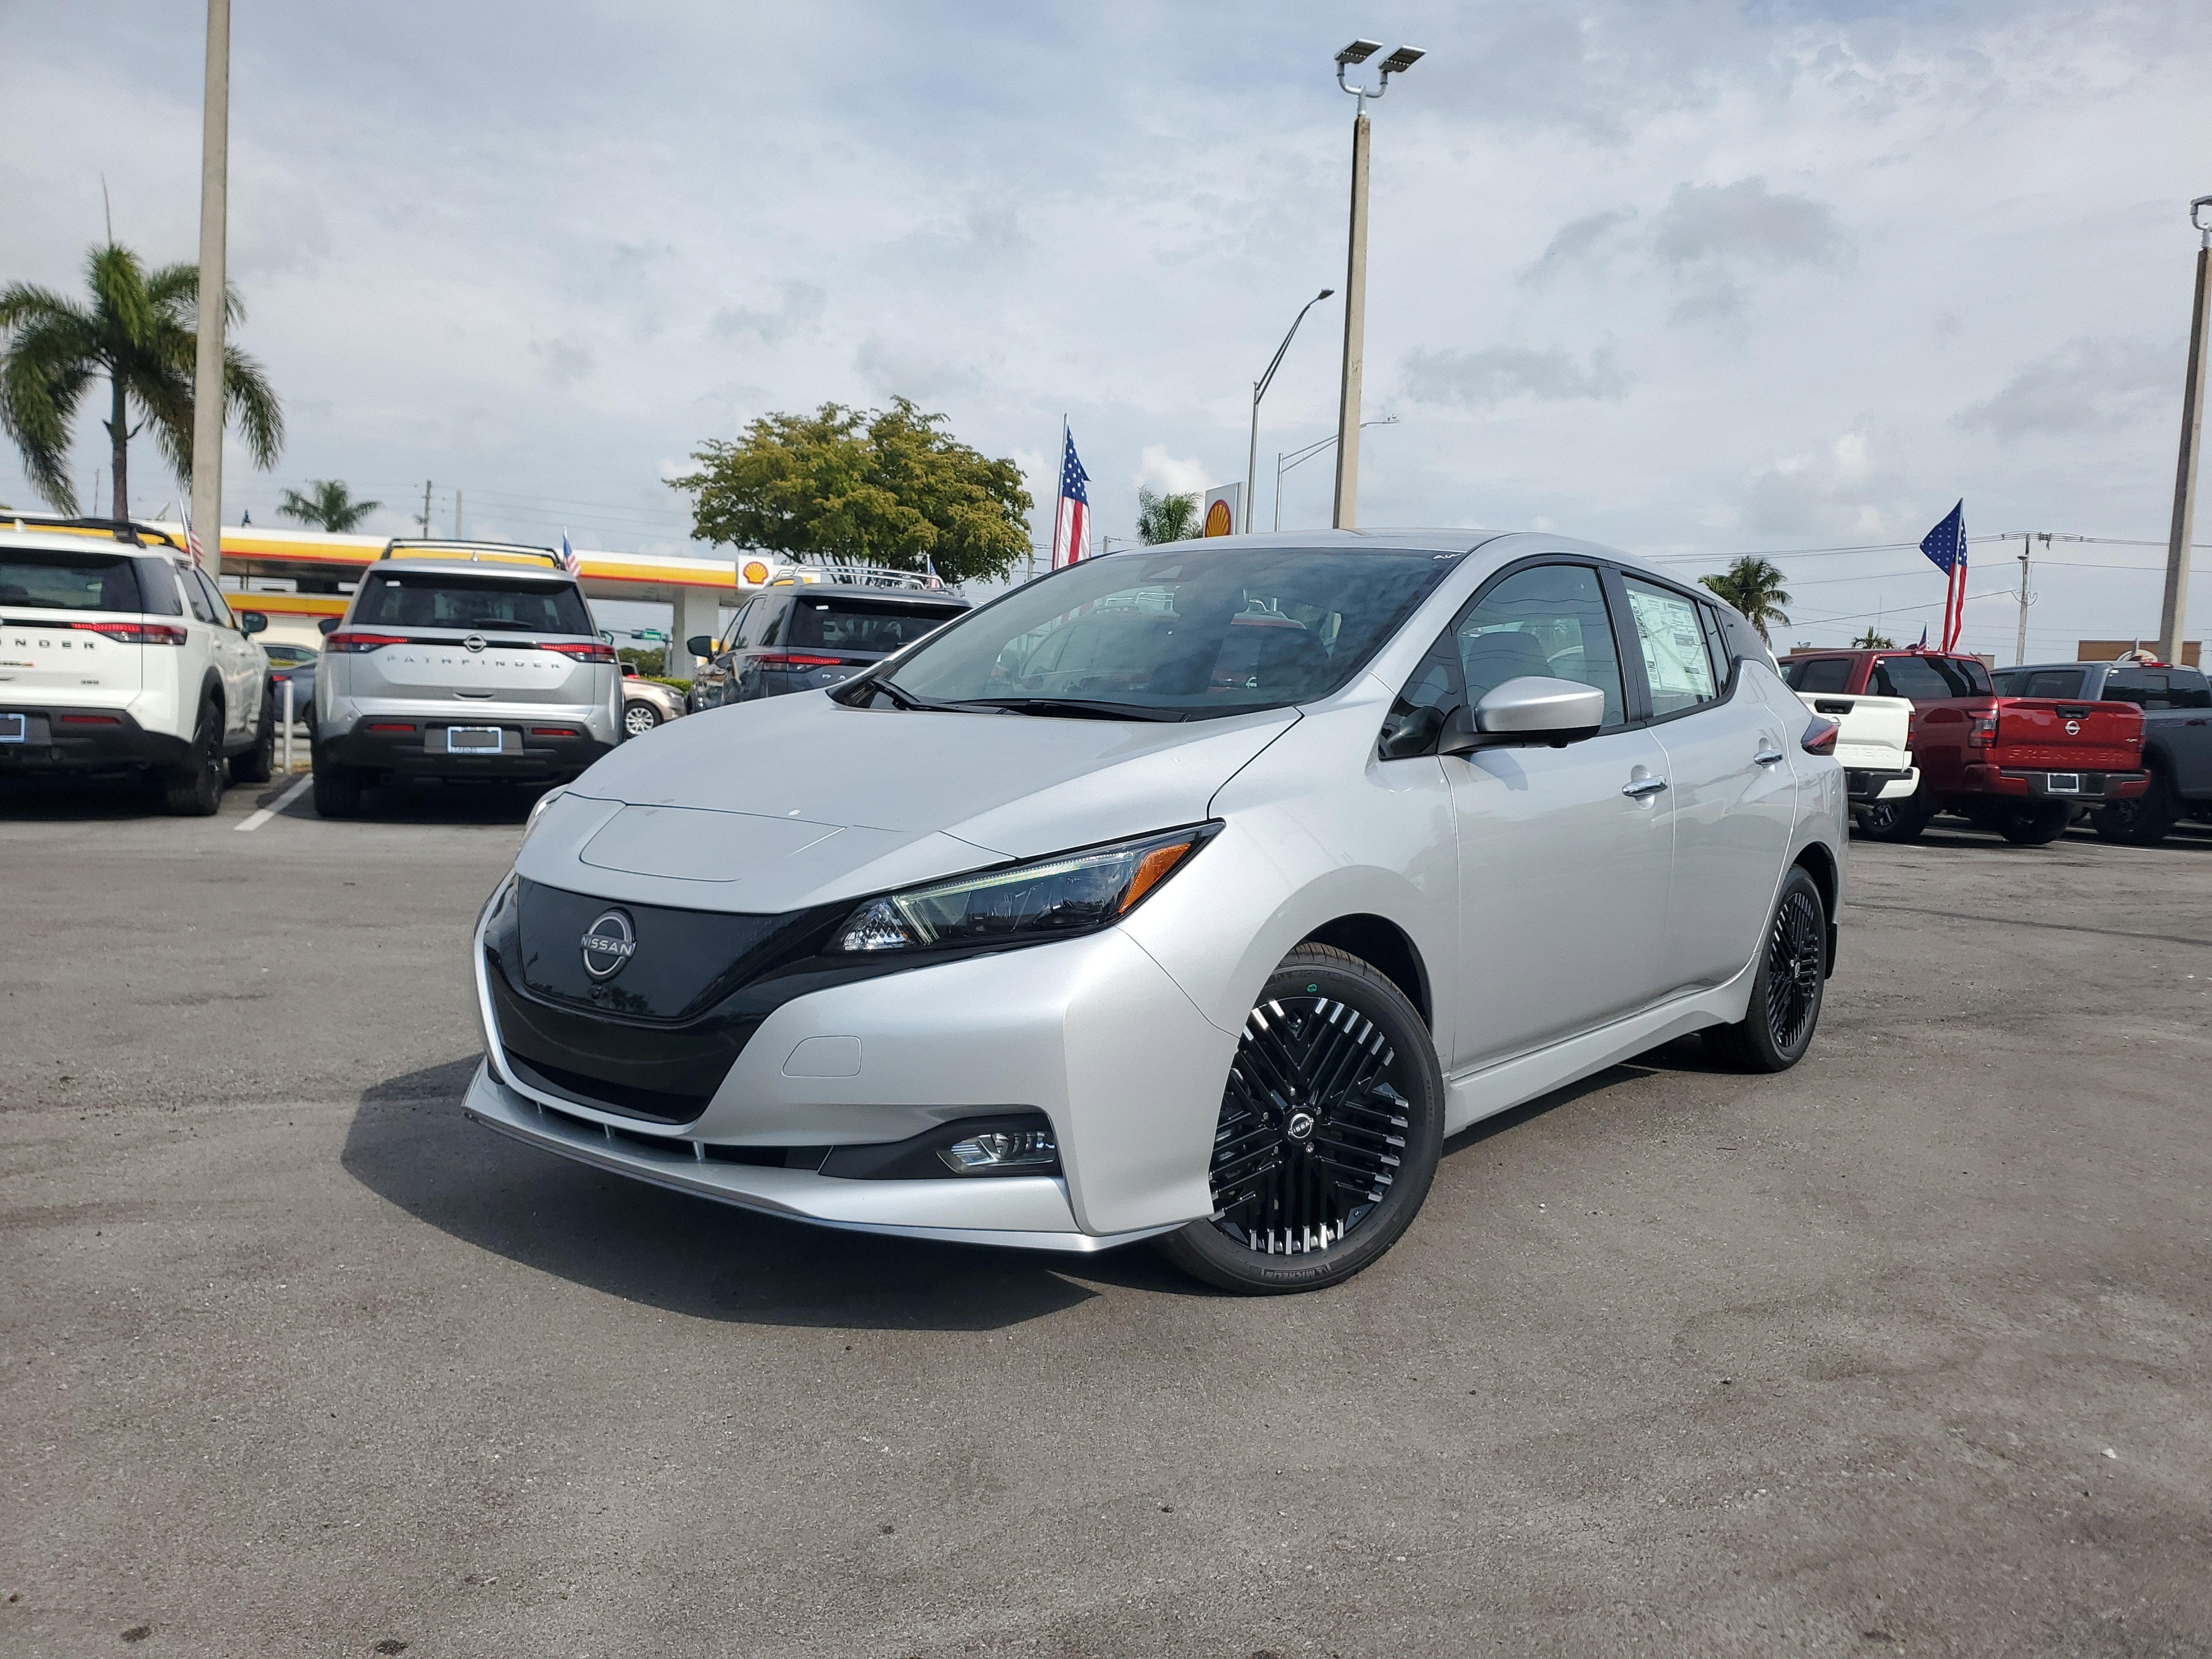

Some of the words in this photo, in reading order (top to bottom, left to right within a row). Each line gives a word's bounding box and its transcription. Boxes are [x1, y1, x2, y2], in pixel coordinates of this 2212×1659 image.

[387, 654, 560, 669] PATHFINDER
[2008, 749, 2123, 762] FRONTIER
[581, 936, 632, 955] NISSAN
[1288, 1118, 1314, 1135] NISSAN
[1266, 1269, 1315, 1280] MICHELIN
